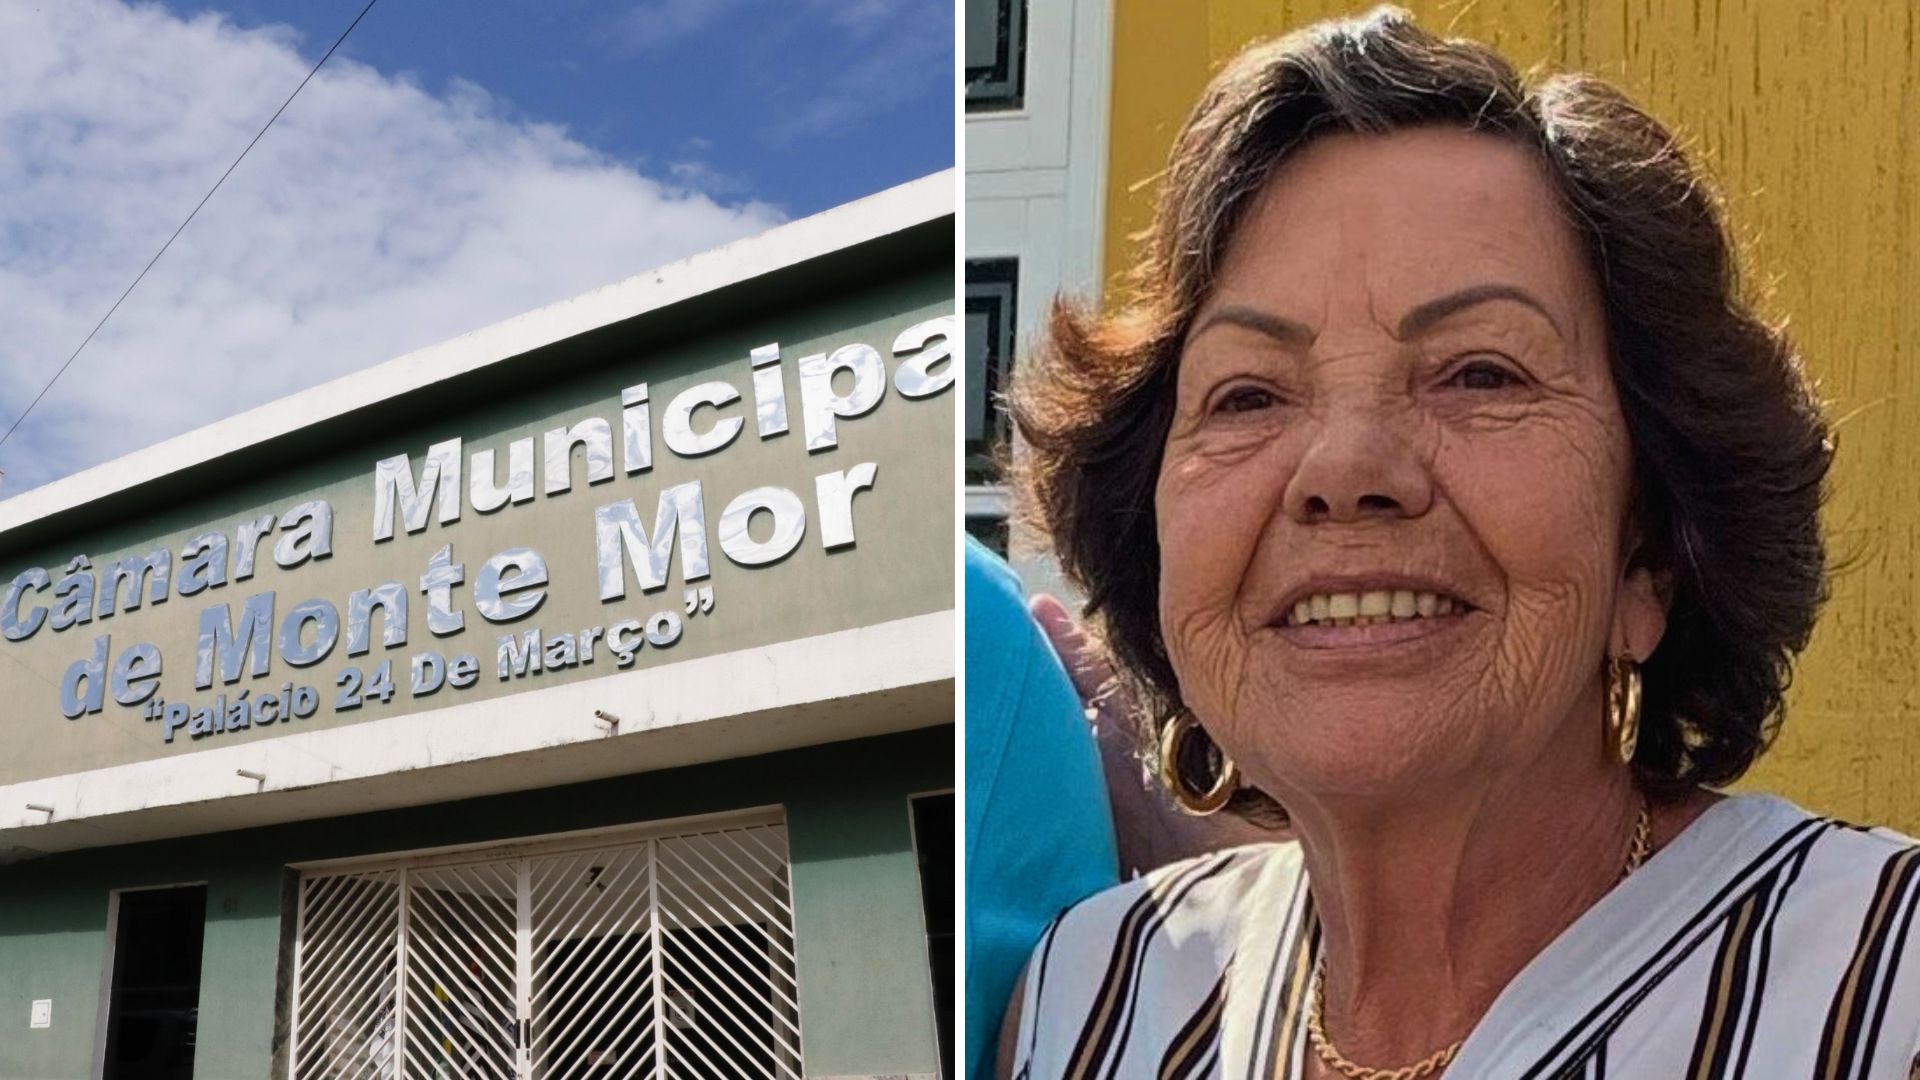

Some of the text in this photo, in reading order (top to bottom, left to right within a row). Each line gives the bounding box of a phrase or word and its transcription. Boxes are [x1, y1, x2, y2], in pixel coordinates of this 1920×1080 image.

[1, 314, 955, 641] Câmara Municipa
[60, 462, 878, 720] de Monte Mor
[336, 660, 395, 712] 24
[412, 650, 480, 699] De
